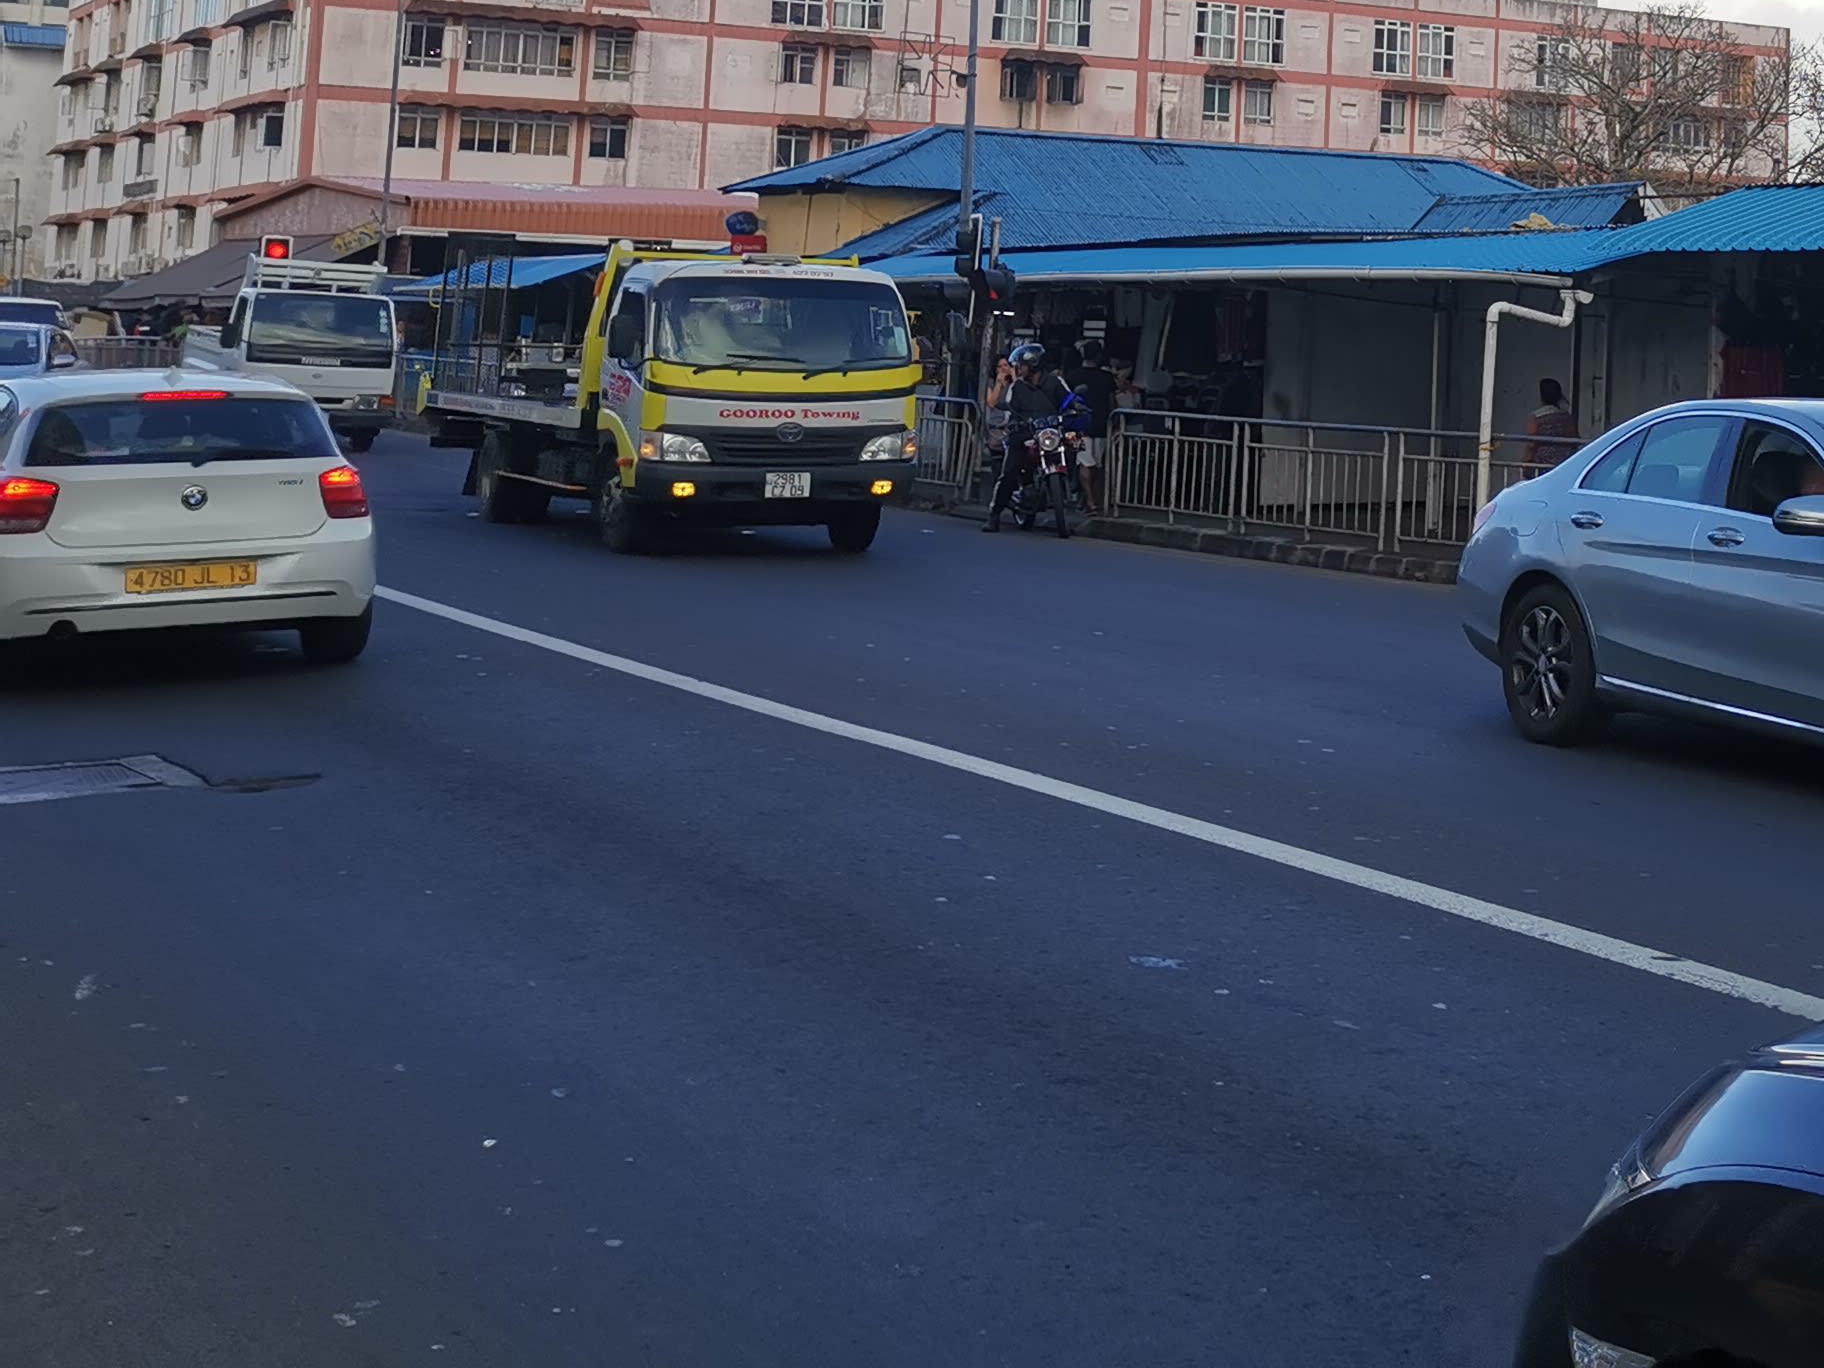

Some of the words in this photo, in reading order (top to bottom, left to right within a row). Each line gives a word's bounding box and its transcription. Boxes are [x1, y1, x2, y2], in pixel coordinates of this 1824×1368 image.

[719, 409, 796, 420] GOOROO
[801, 409, 860, 420] Towing
[133, 569, 186, 588] 4780
[193, 566, 217, 585] JL
[229, 563, 251, 583] 13
